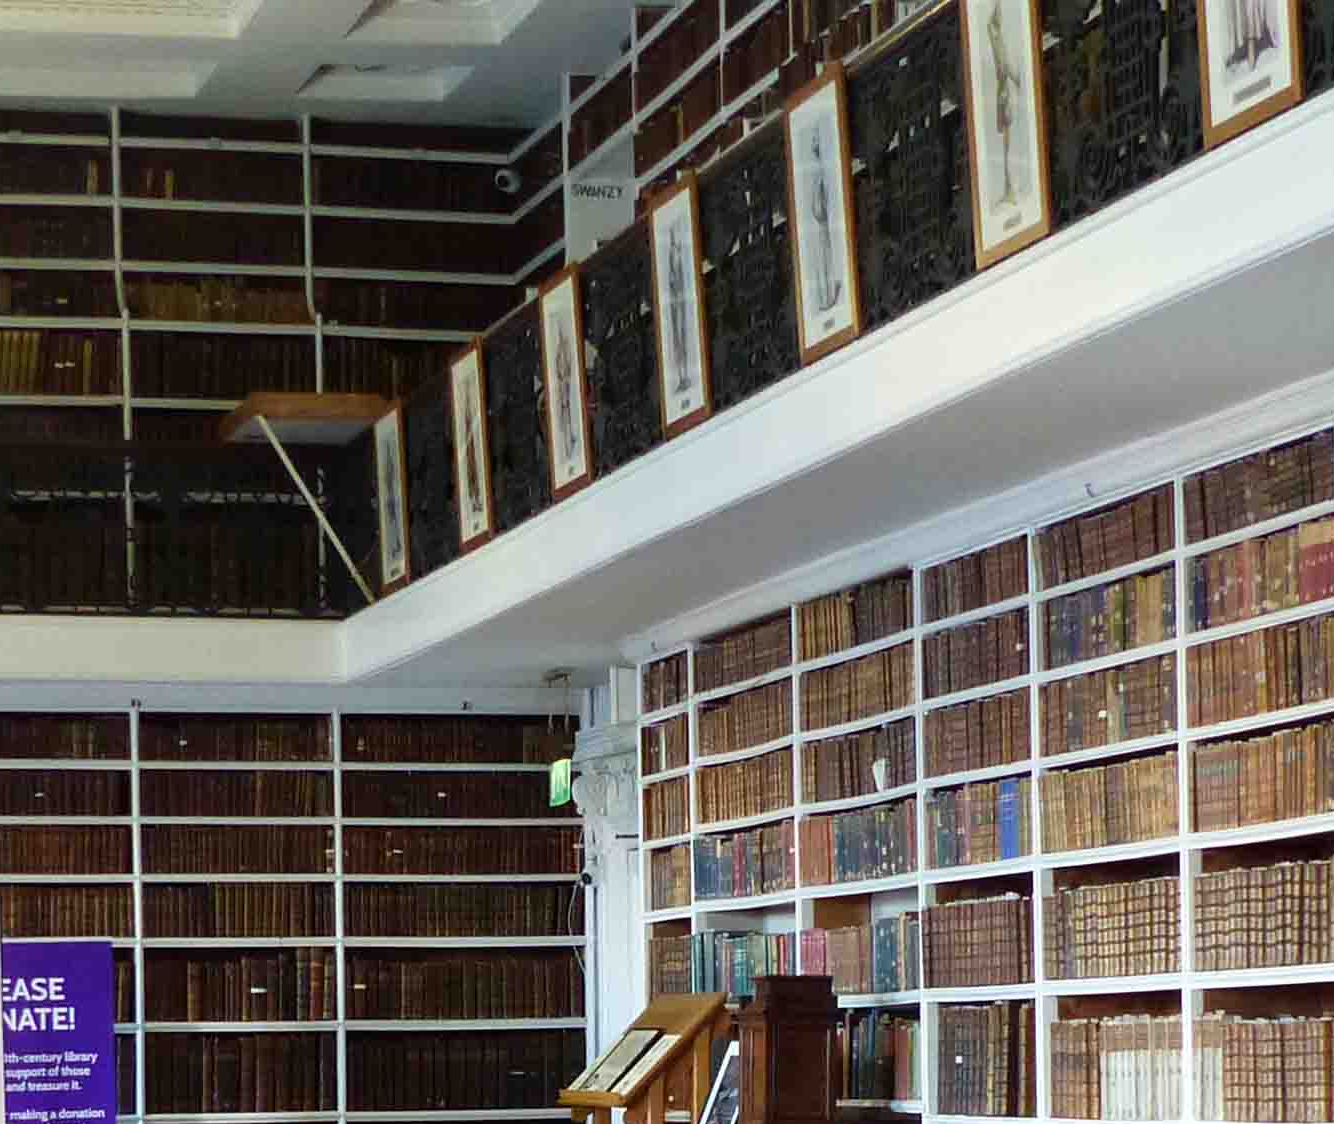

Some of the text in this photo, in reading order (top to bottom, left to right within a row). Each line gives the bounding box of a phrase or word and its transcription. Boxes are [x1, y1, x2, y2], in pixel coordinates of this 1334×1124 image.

[570, 184, 623, 199] SWANZY
[2, 977, 66, 1001] EASE
[3, 1006, 76, 1031] NATE!
[64, 1050, 98, 1064] library
[5, 1065, 91, 1080] support of those
[6, 1081, 26, 1092] and
[9, 1107, 106, 1122] making a donation
